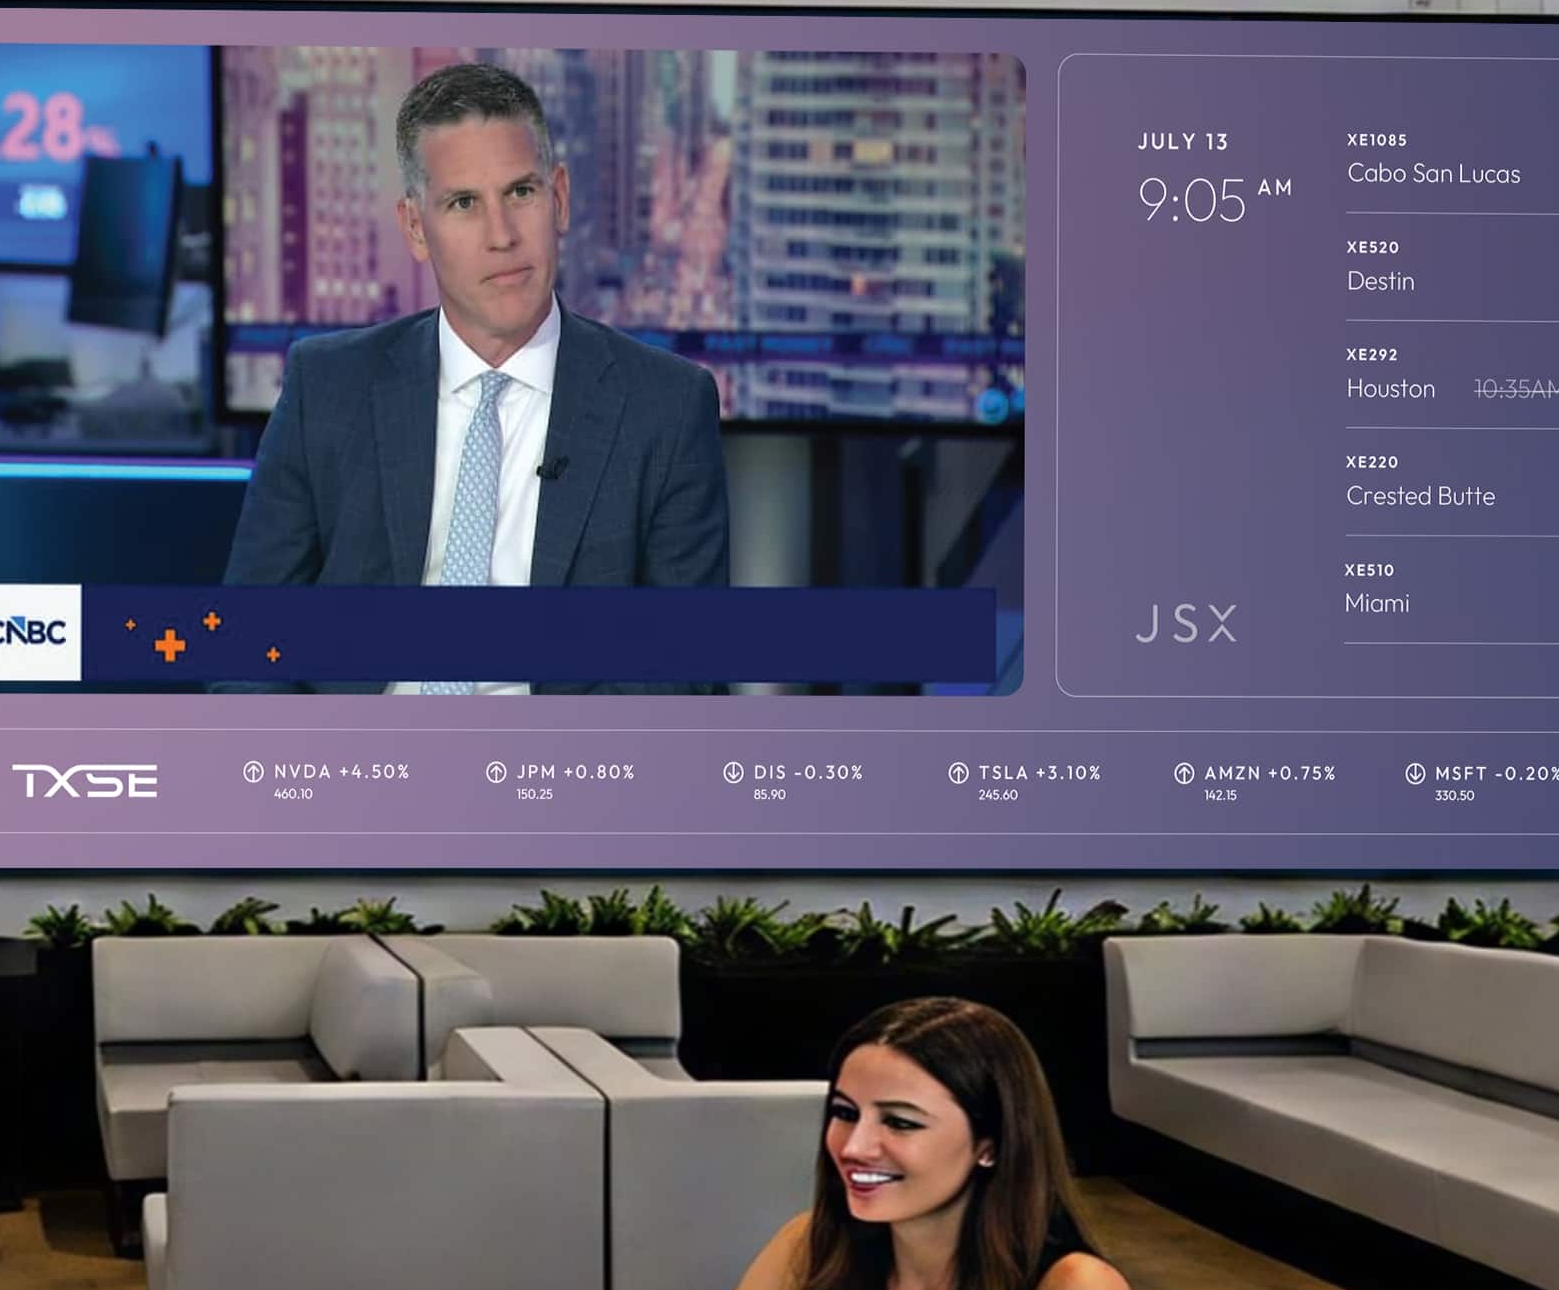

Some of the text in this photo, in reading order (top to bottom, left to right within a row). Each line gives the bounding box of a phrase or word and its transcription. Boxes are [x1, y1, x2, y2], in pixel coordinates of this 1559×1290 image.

[1138, 133, 1227, 150] JULY 13
[1348, 134, 1406, 146] XE1085
[1349, 163, 1406, 182] Cabo
[1414, 163, 1452, 183] San
[1460, 164, 1520, 183] Lucas
[1140, 178, 1291, 222] 9:05 AM
[1347, 241, 1398, 253] XE520
[1349, 271, 1414, 290] Destin
[1347, 349, 1397, 360] XE292
[1348, 378, 1434, 398] Houston
[1347, 456, 1397, 468] XE220
[1347, 486, 1431, 505] Crested
[1439, 486, 1495, 505] Butte
[1345, 564, 1394, 576] XE510
[1346, 593, 1409, 612] Miami
[1136, 604, 1236, 643] JSX
[275, 764, 409, 778] NVDA +4.50%
[517, 765, 634, 779] JPM +0.80%
[755, 765, 862, 779] DIS -0.30%
[979, 766, 1100, 780] TSLA +3.10%
[1205, 766, 1335, 780] AMZN +0.75%
[1436, 766, 1486, 780] MSFT
[12, 764, 157, 797] TXSE
[274, 788, 313, 799] 460.10
[517, 789, 553, 799] 150.25
[754, 789, 786, 799] 85.90
[979, 789, 1018, 800] 245.60
[1205, 790, 1237, 800] 142.15
[1435, 790, 1474, 801] 330.50
